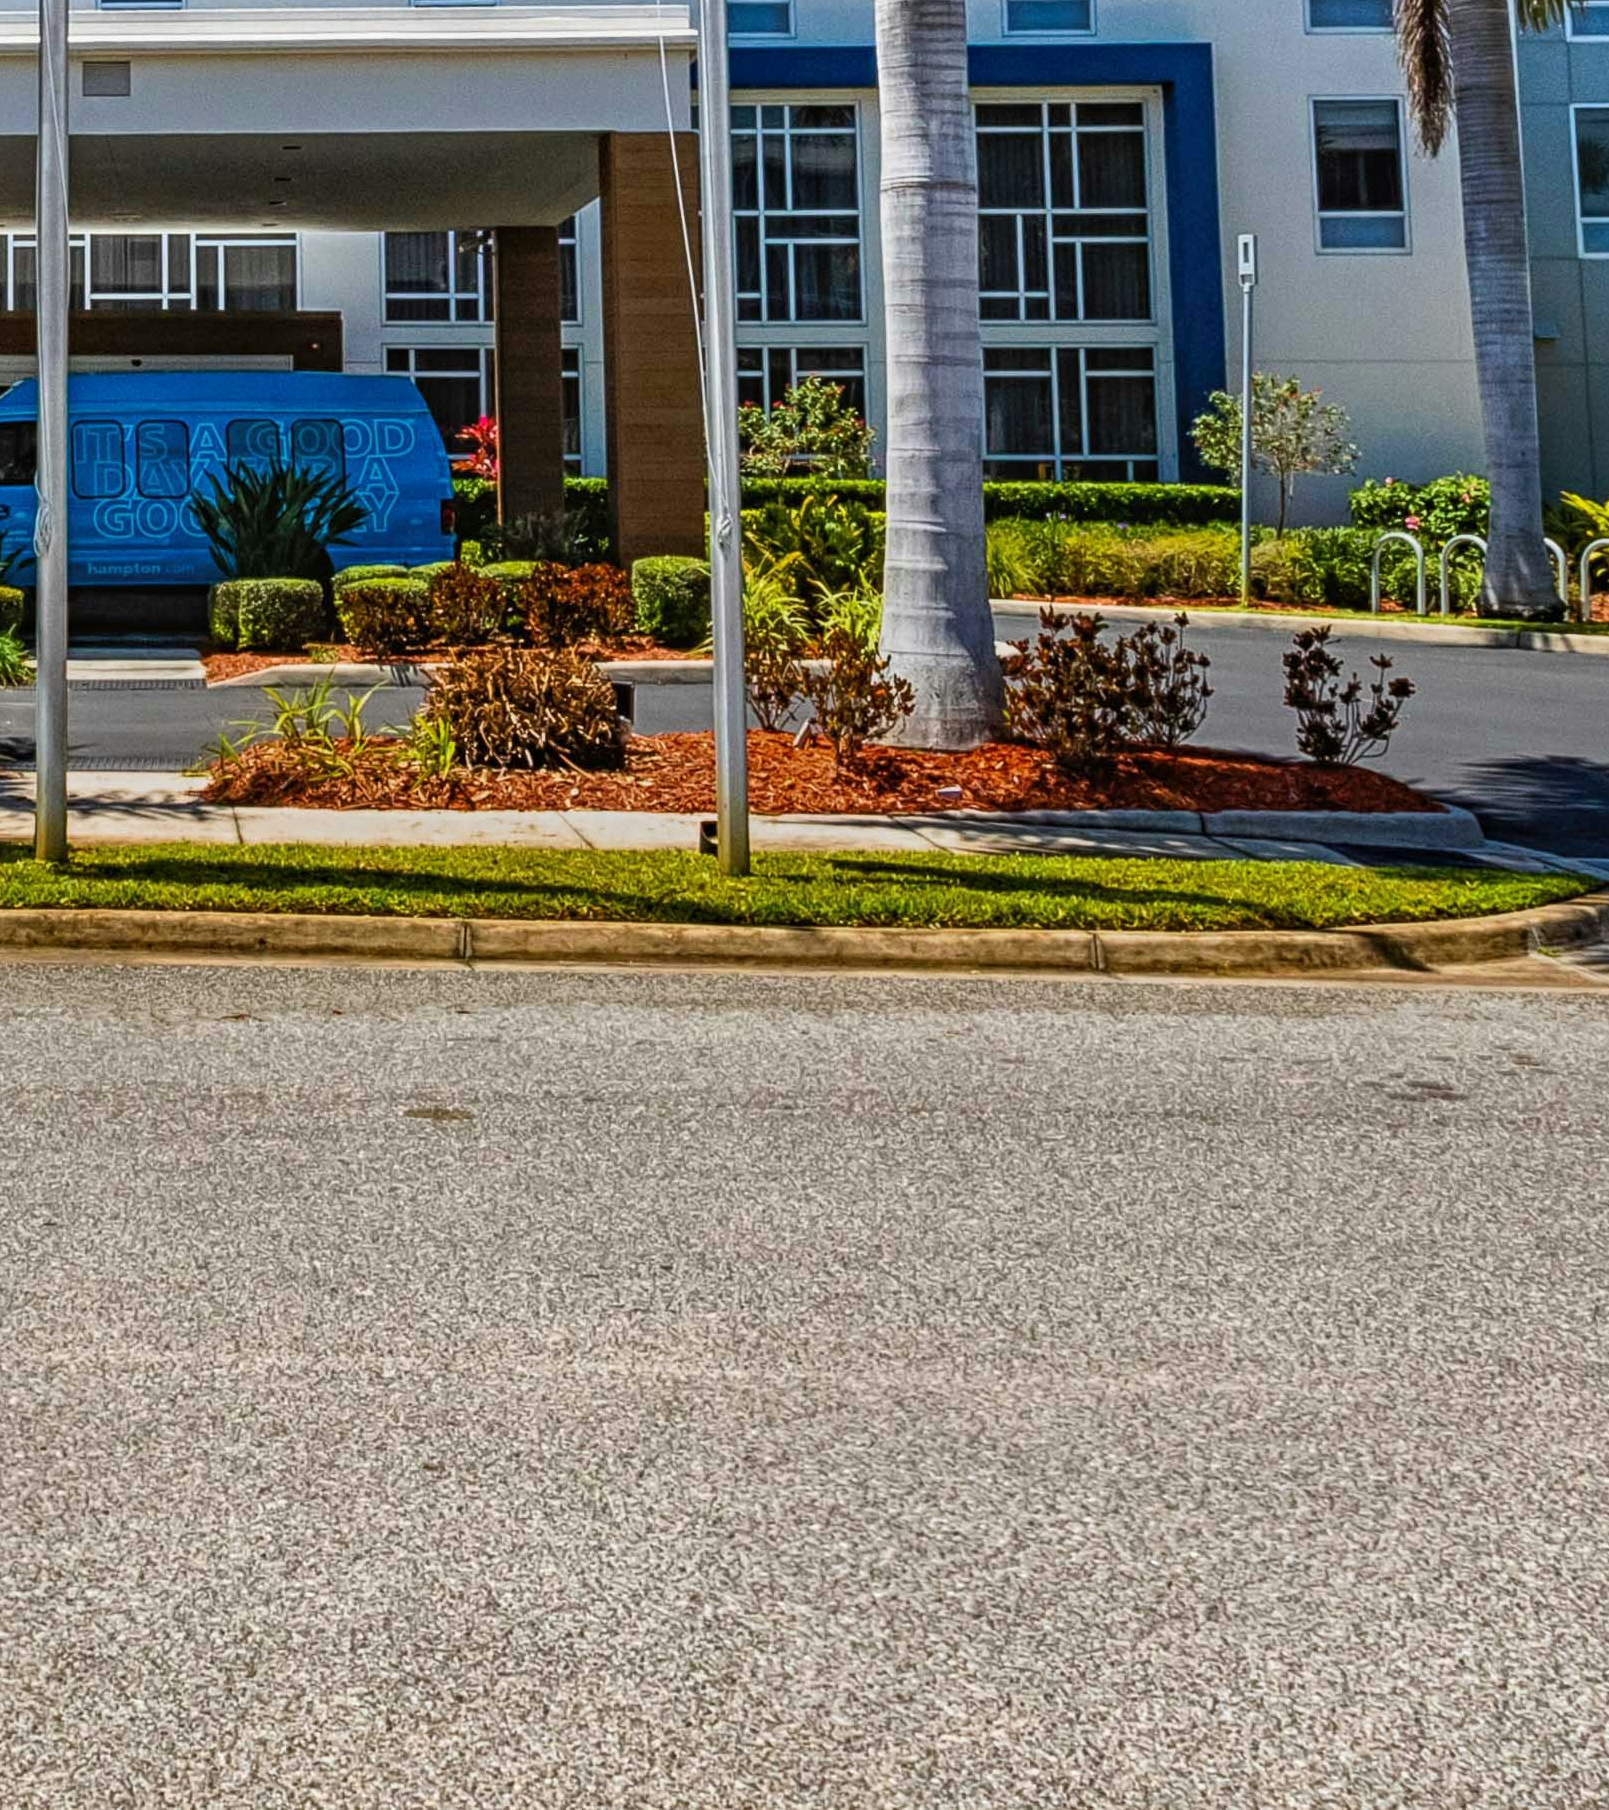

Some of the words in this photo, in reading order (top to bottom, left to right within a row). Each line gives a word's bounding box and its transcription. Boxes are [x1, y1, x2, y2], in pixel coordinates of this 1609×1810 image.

[73, 423, 168, 464] IT'S
[188, 422, 229, 462] A
[245, 418, 416, 461] GOOD
[357, 454, 400, 494] A
[93, 494, 222, 538] GOO
